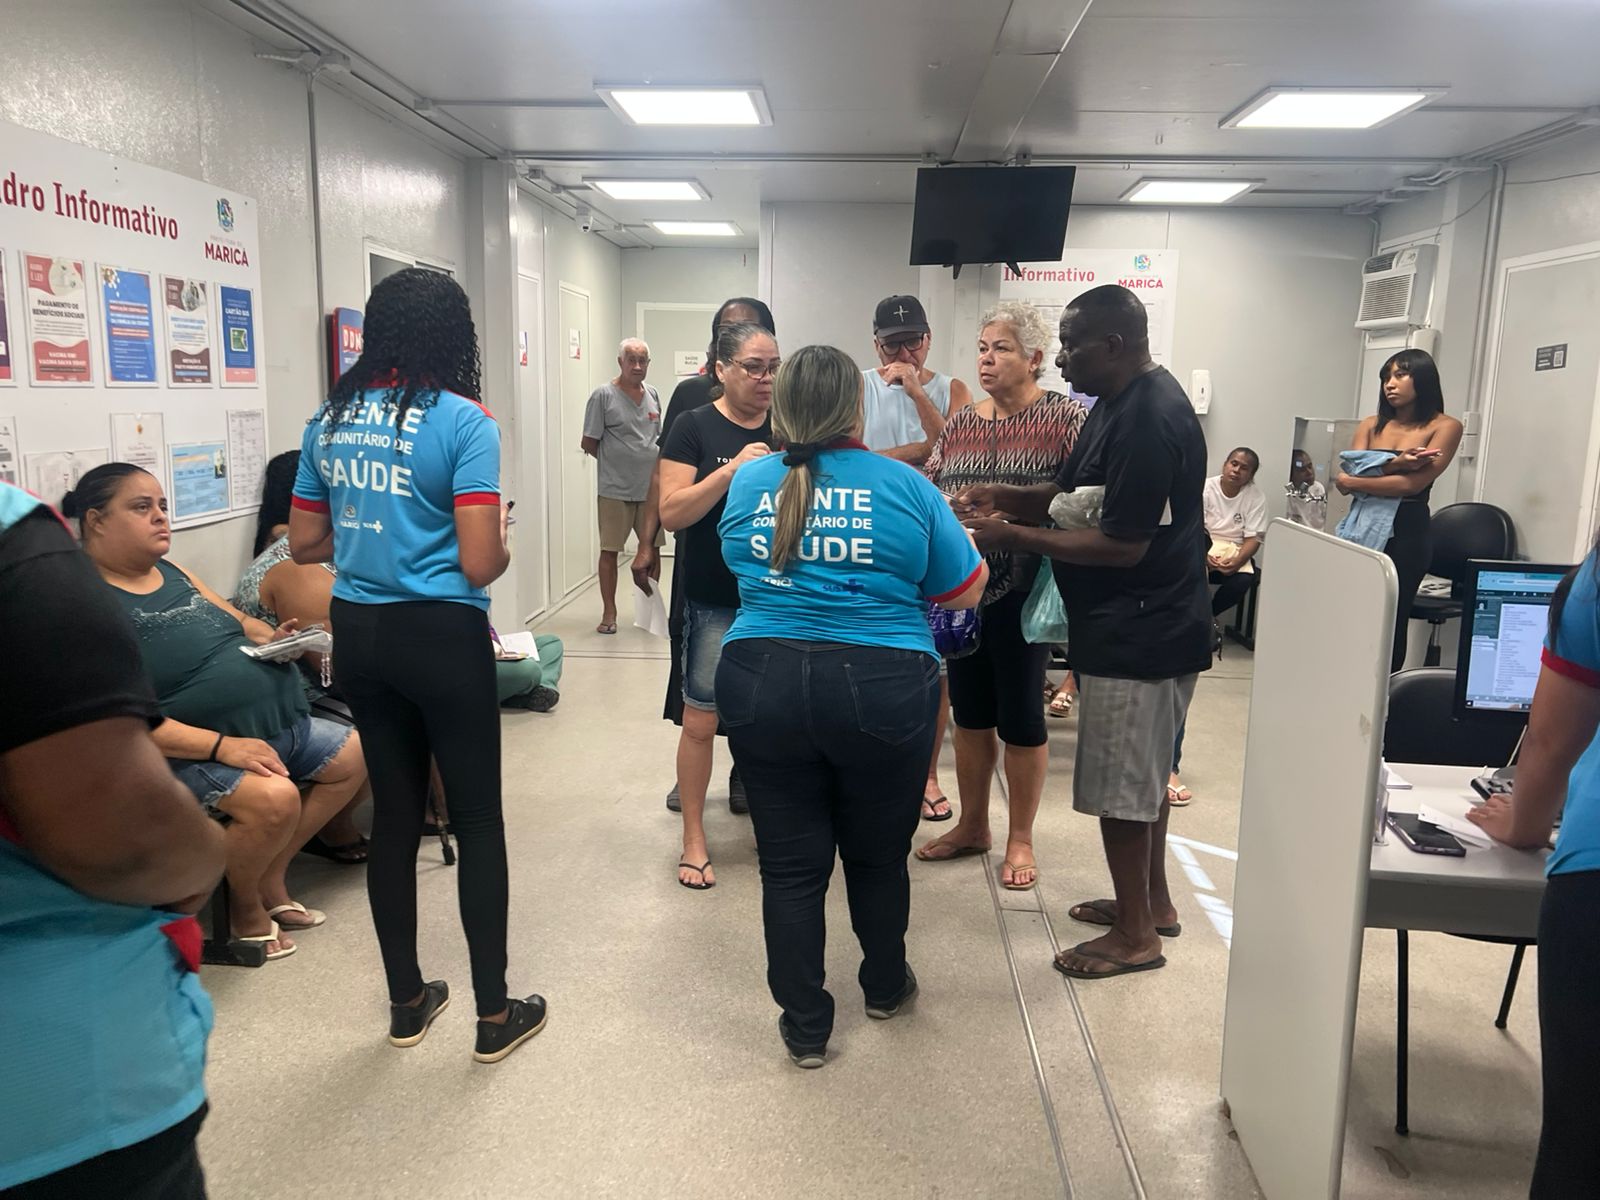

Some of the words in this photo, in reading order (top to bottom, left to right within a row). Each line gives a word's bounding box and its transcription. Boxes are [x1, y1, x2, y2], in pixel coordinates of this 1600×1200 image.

[0, 171, 44, 211] dro
[53, 182, 178, 240] Informativo
[320, 451, 413, 498] SAÚDE
[852, 517, 873, 530] DE
[750, 530, 874, 565] SÚDE
